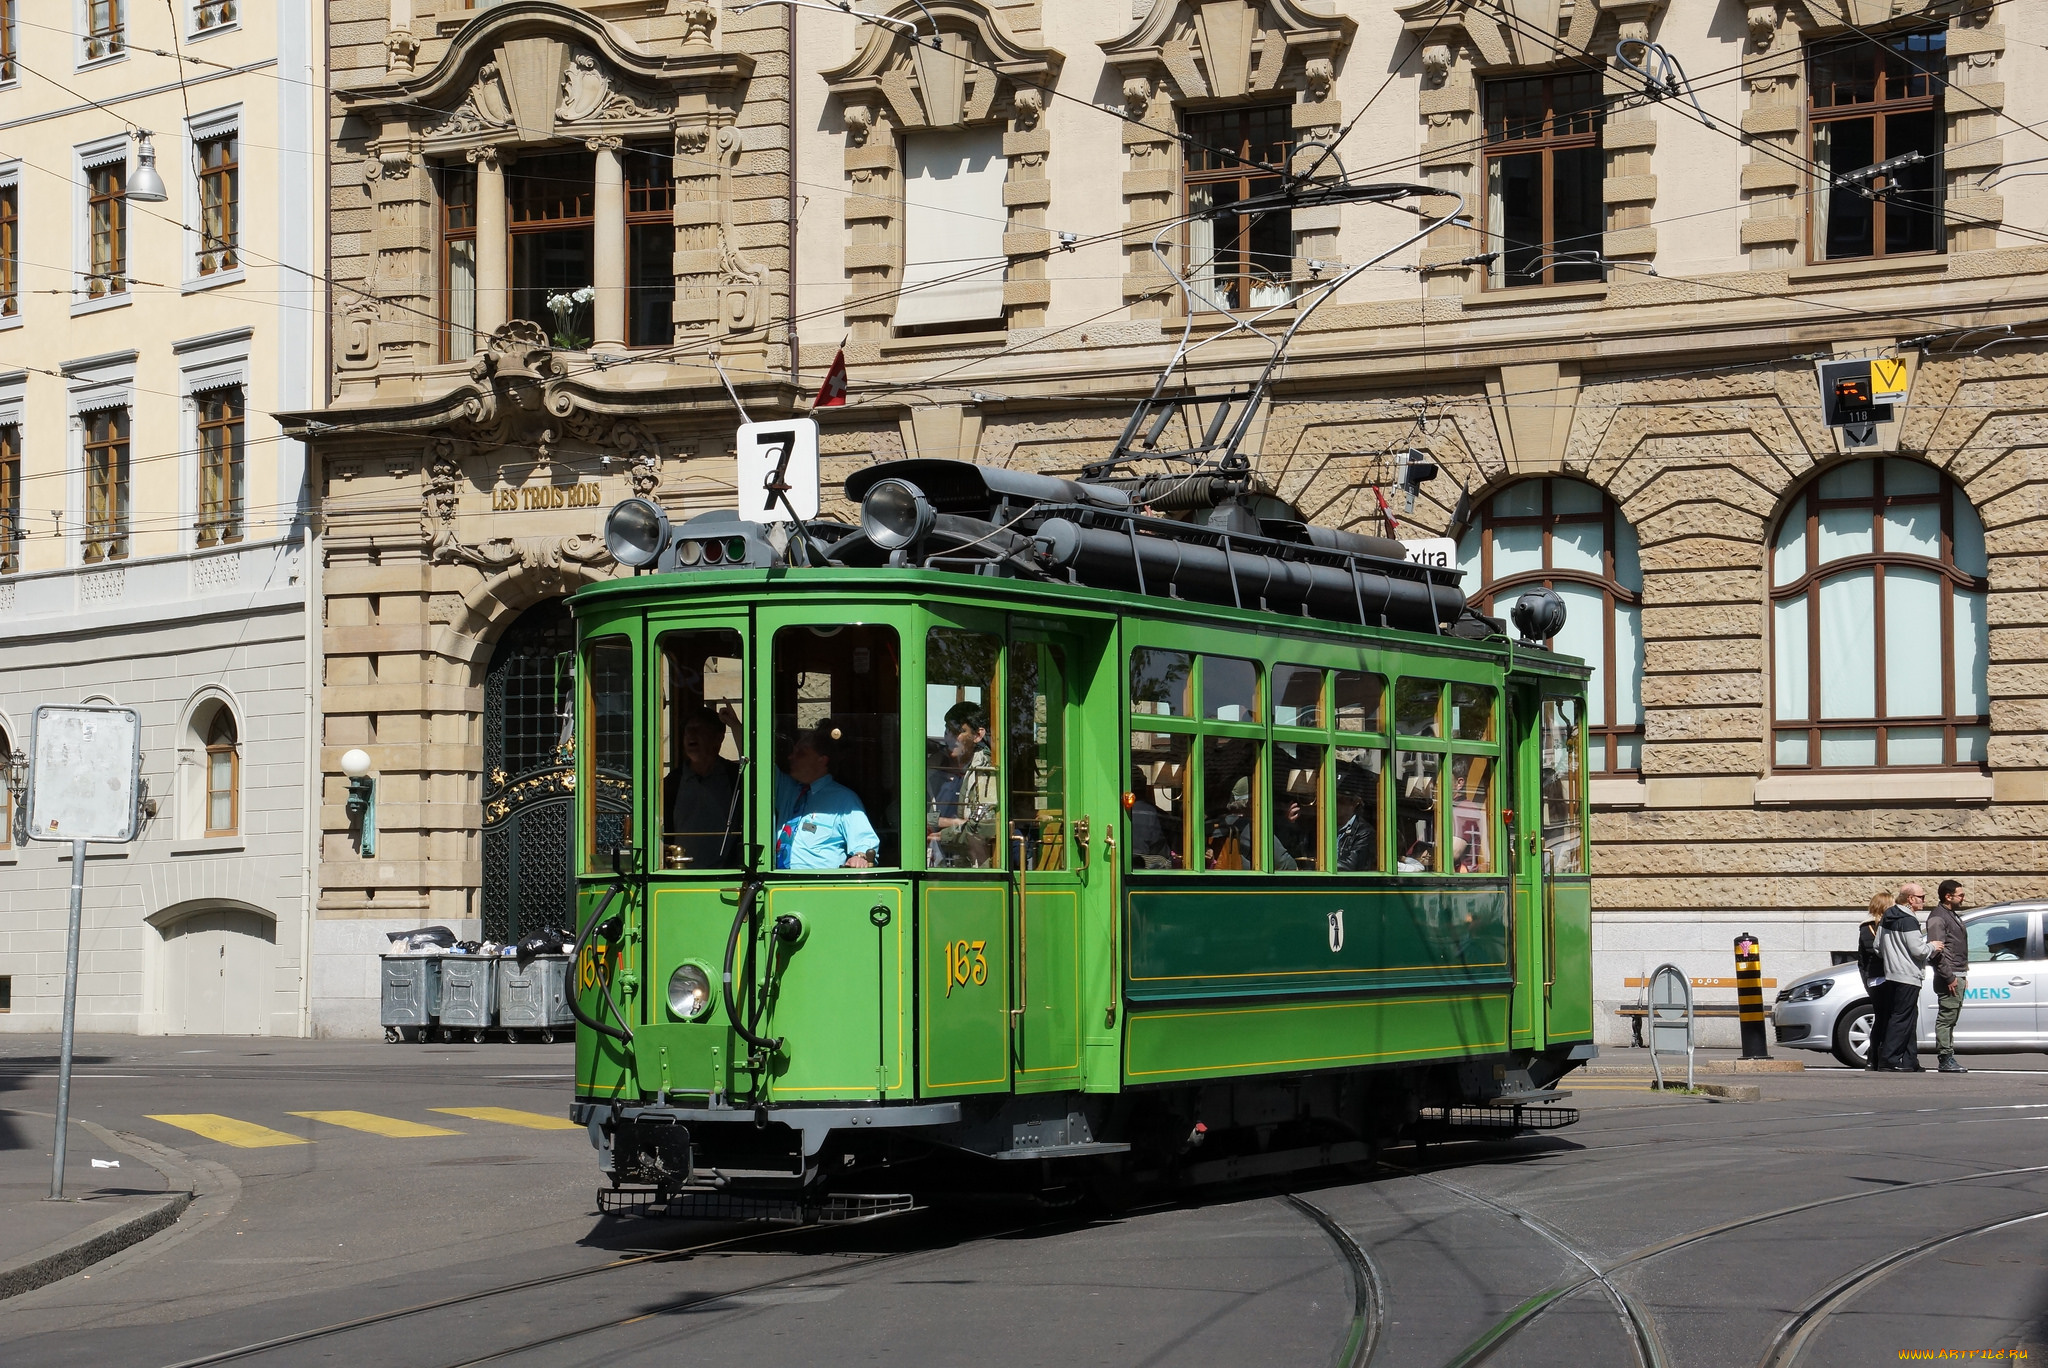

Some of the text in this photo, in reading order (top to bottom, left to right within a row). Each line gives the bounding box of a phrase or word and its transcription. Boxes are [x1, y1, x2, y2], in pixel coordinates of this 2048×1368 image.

[1849, 411, 1868, 422] 118
[756, 430, 796, 511] 7
[492, 482, 601, 511] LES TROIS ROIS
[1406, 548, 1447, 567] xtra
[578, 944, 611, 1001] 163
[945, 940, 988, 999] 163
[1964, 988, 2011, 999] MENS
